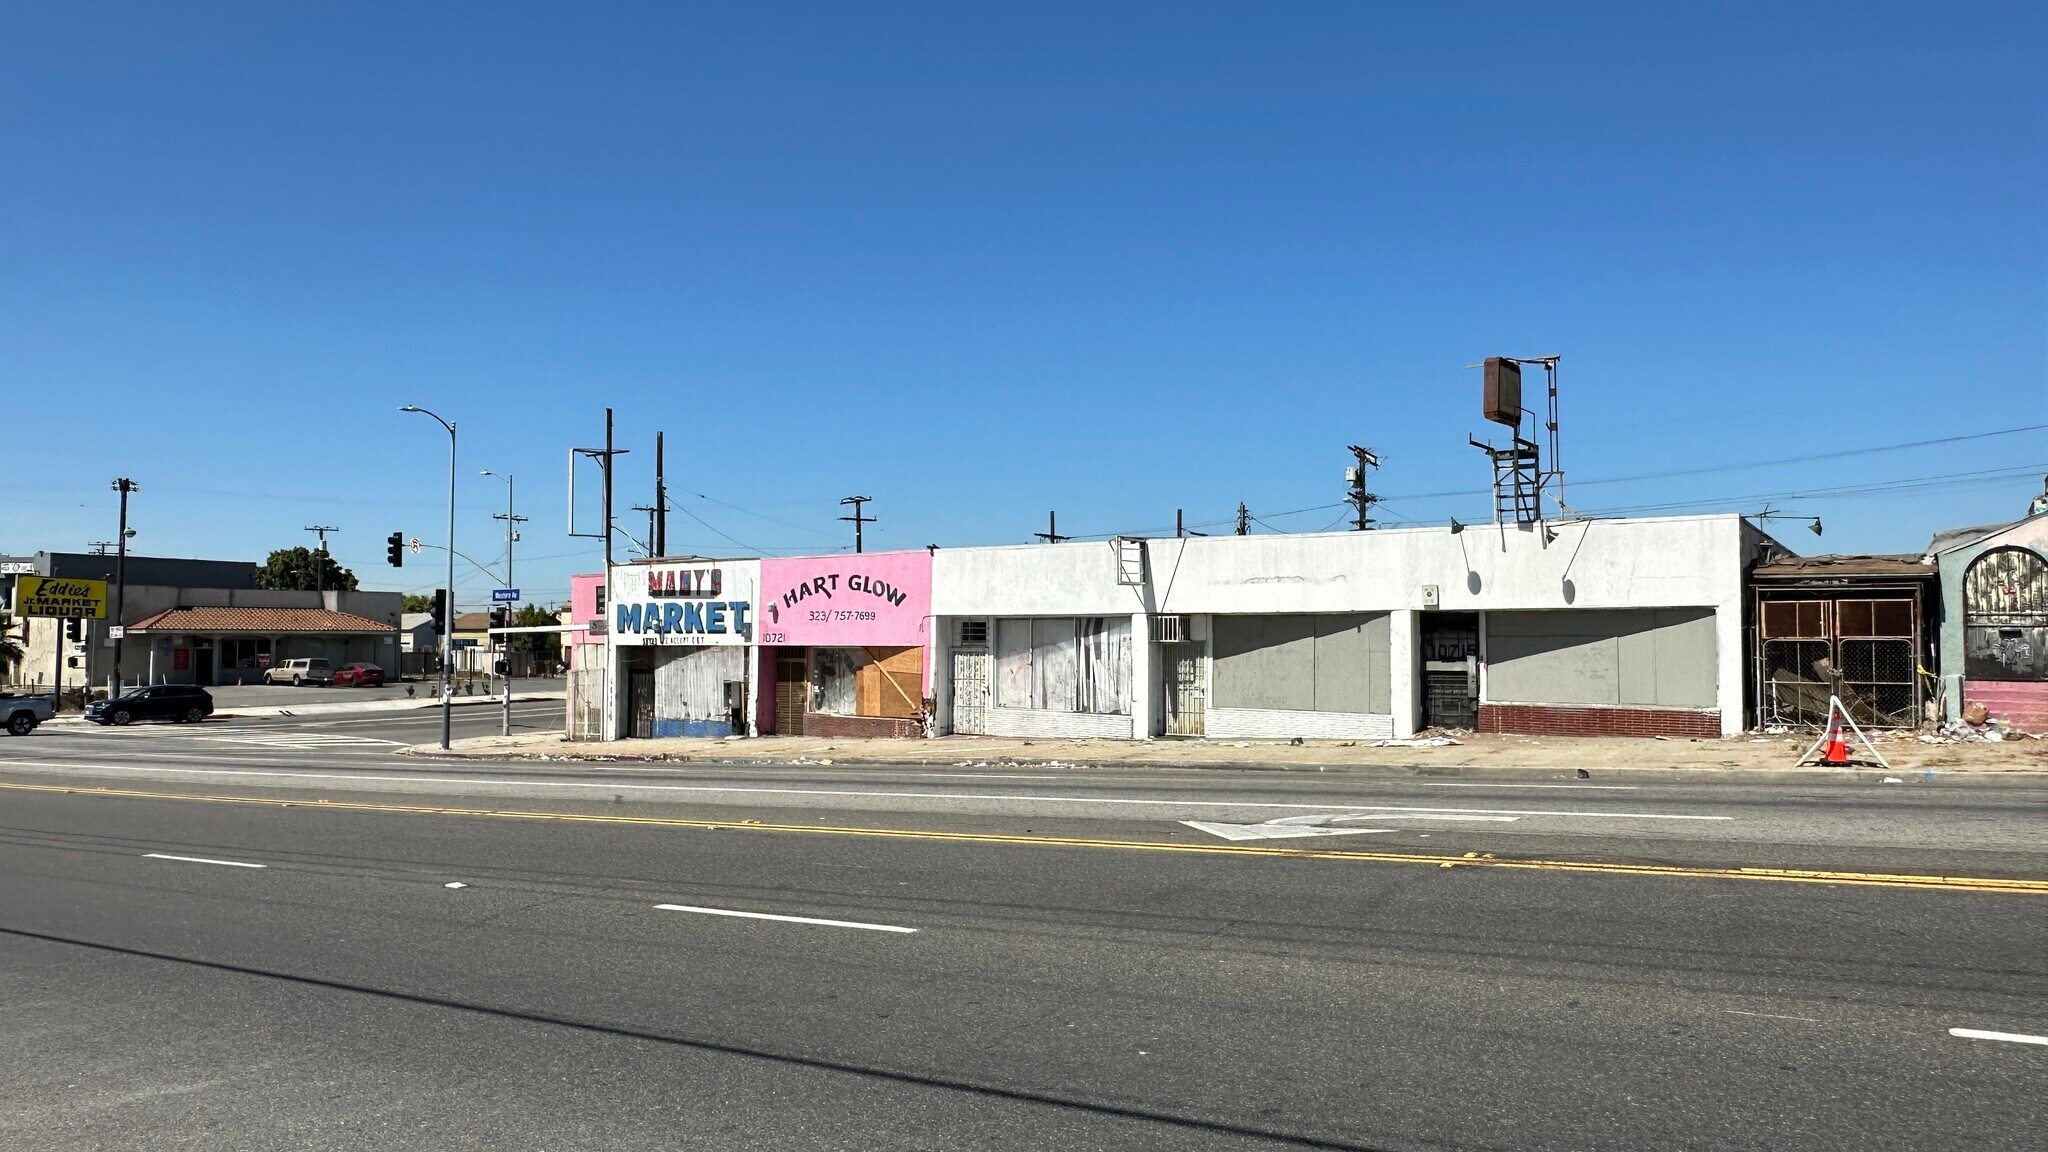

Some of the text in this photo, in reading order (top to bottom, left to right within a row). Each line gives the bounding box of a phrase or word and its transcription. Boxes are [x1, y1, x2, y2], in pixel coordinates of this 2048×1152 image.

[35, 578, 91, 598] Eddie's
[783, 574, 907, 609] HART GLOW
[36, 597, 102, 607] MARKET
[27, 605, 97, 617] LIQUOR
[834, 610, 876, 621] 757-7699
[616, 600, 751, 635] MARKET
[762, 633, 786, 643] 10721
